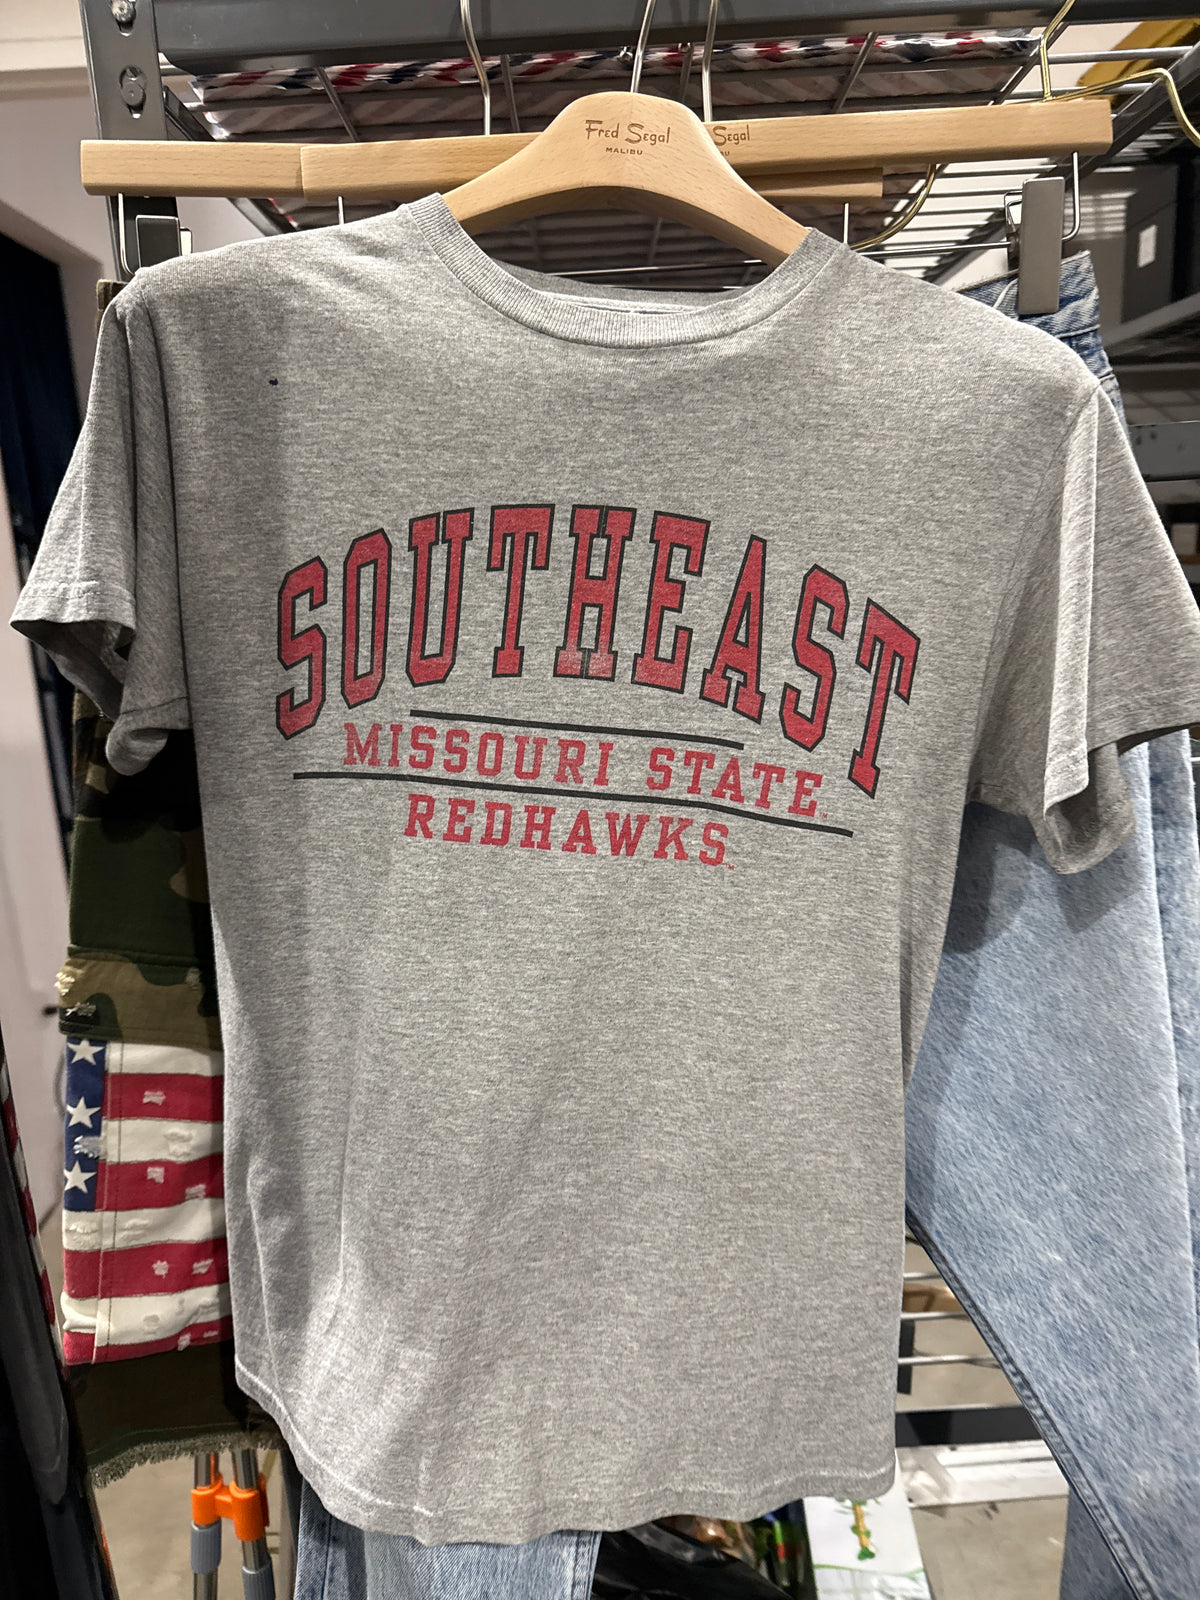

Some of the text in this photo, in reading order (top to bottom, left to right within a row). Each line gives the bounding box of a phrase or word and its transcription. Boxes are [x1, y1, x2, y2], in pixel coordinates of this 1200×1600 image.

[585, 119, 671, 145] Fred Segal
[605, 147, 643, 156] MALIBU
[712, 124, 750, 146] Segal
[276, 504, 921, 799] SOUTHEAST
[343, 723, 823, 817] MISSOURI STATE
[403, 793, 729, 866] REDHAWKS
